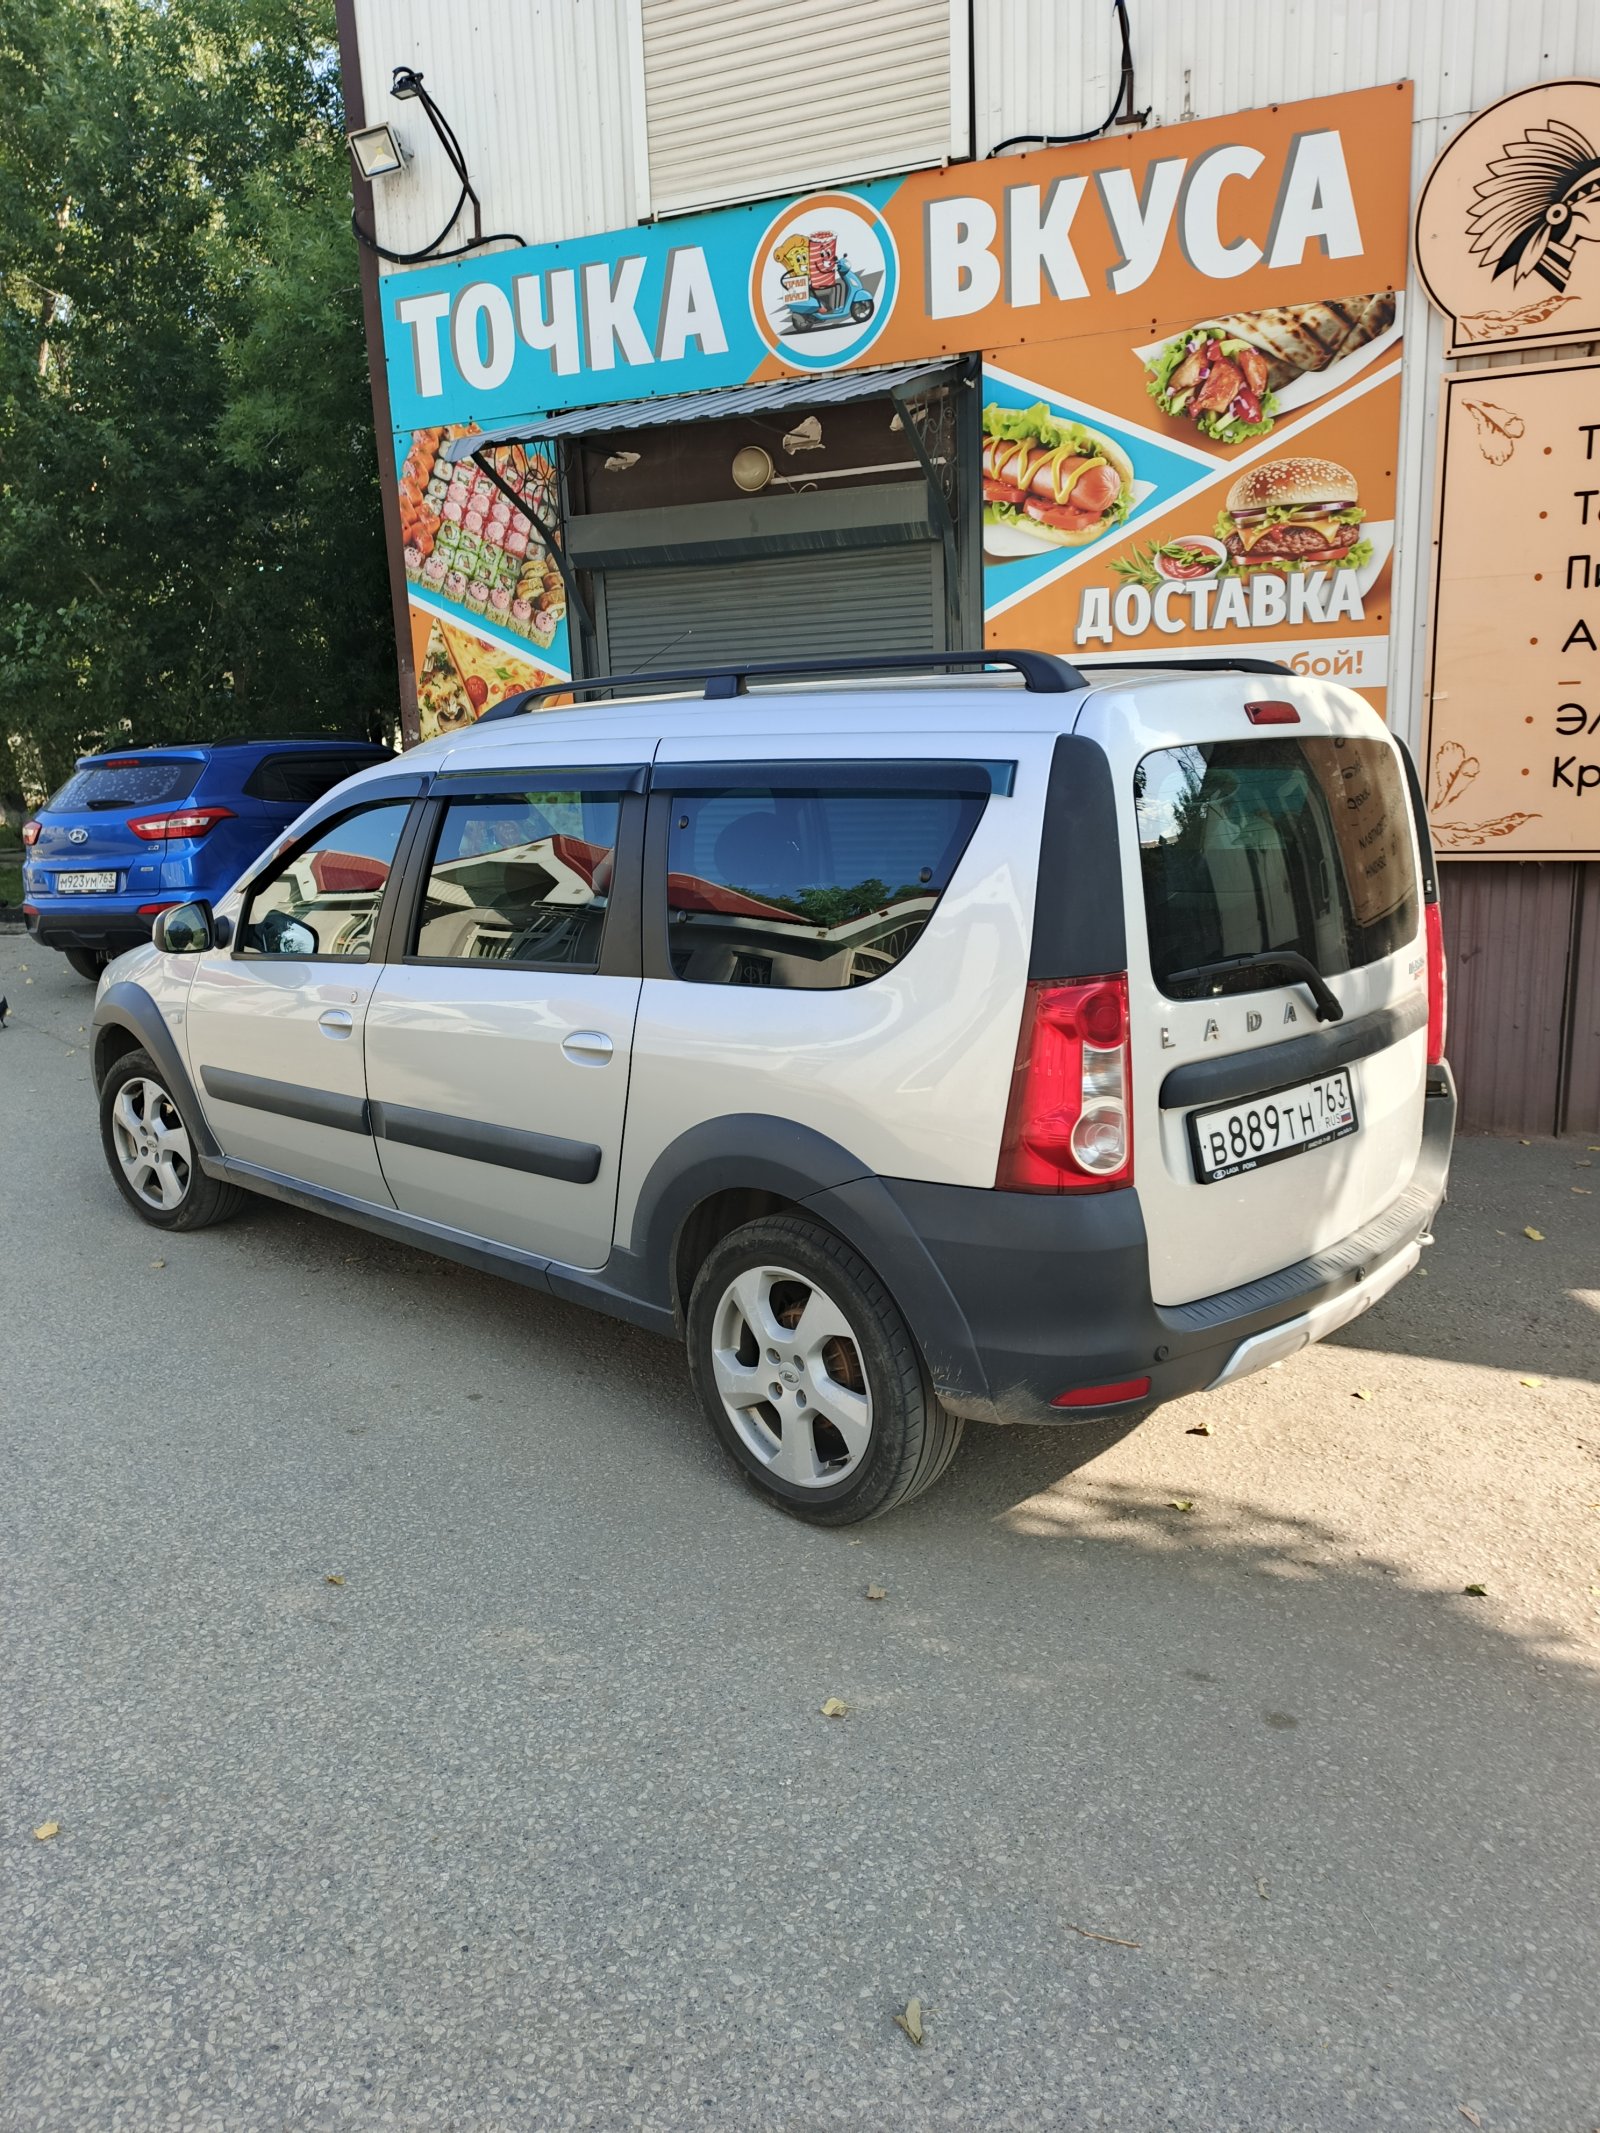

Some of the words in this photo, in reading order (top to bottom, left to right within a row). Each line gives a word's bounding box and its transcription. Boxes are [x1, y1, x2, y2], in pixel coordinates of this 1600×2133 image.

[397, 246, 729, 398] ТОЧКА
[925, 130, 1365, 320] ВКУСА
[1574, 490, 1600, 525] Т
[1075, 568, 1365, 645] ДОСТАВКА
[1160, 1001, 1298, 1050] LADA
[1313, 1078, 1347, 1117] 763
[1324, 1112, 1342, 1128] RUS
